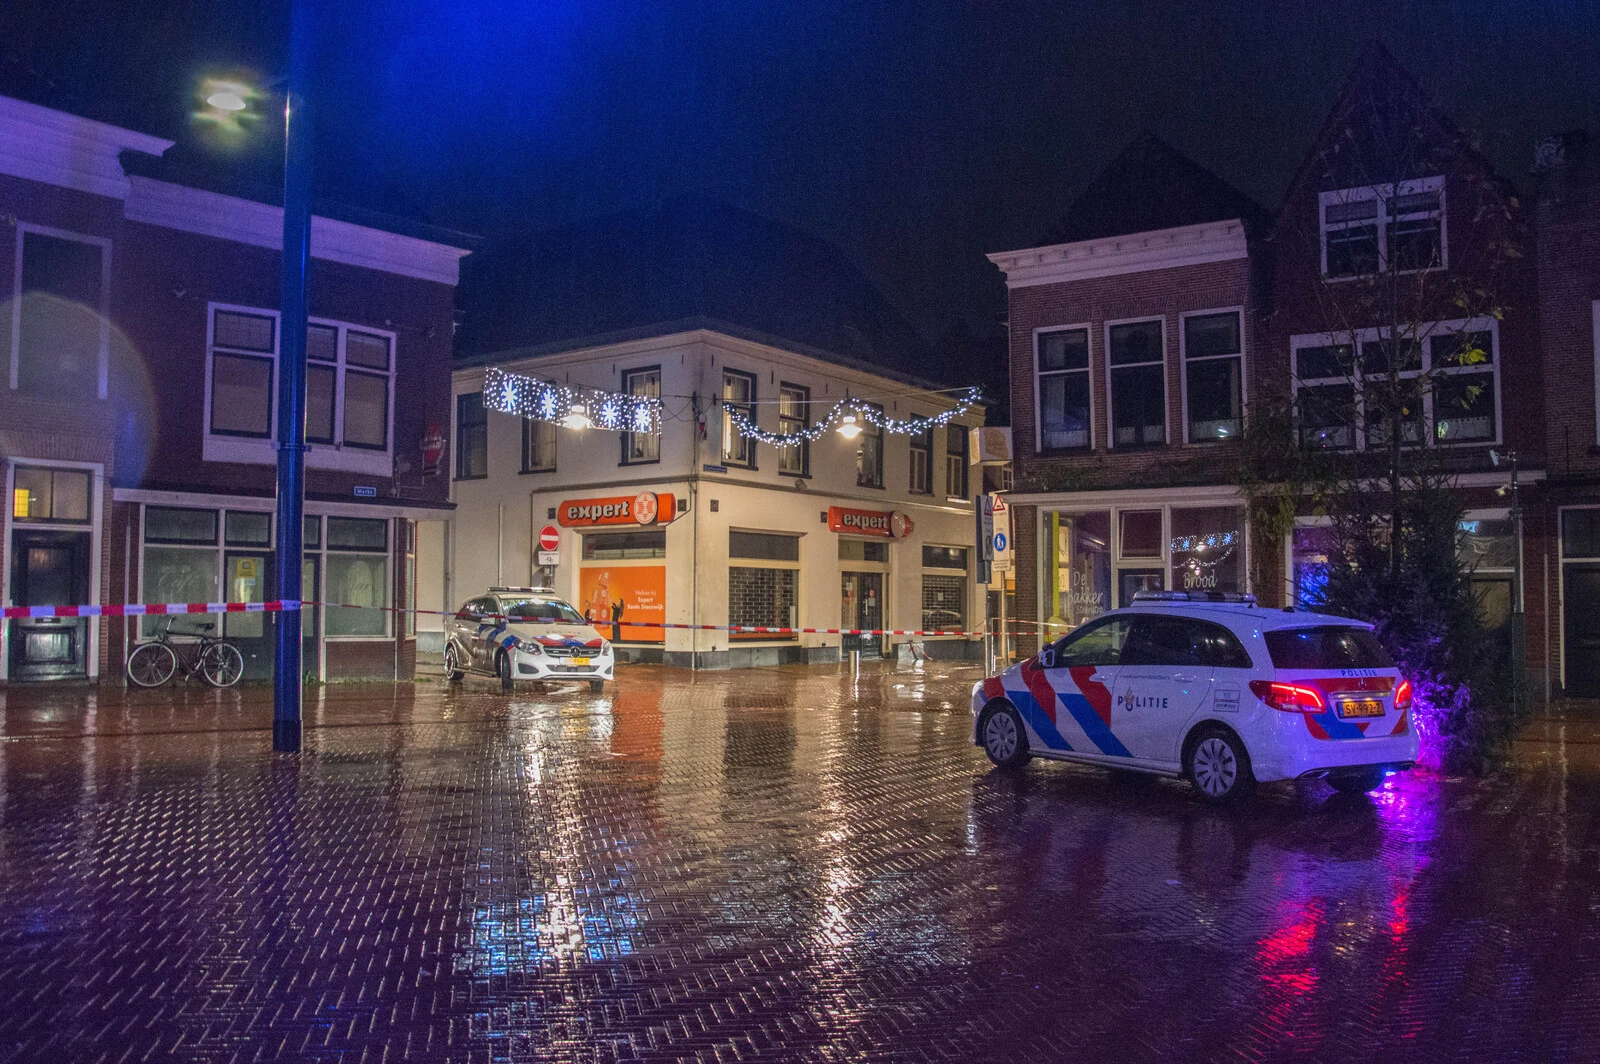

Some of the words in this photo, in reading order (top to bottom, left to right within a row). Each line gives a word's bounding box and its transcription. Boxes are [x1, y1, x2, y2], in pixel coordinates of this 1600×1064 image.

[567, 501, 629, 520] expert
[843, 513, 888, 530] expert
[1073, 571, 1087, 586] De
[1183, 569, 1218, 589] Brood
[1067, 586, 1104, 604] Bakker
[1341, 669, 1378, 677] POLITIE
[1117, 694, 1168, 712] POLITIE
[1345, 702, 1382, 715] SV-992-Z
